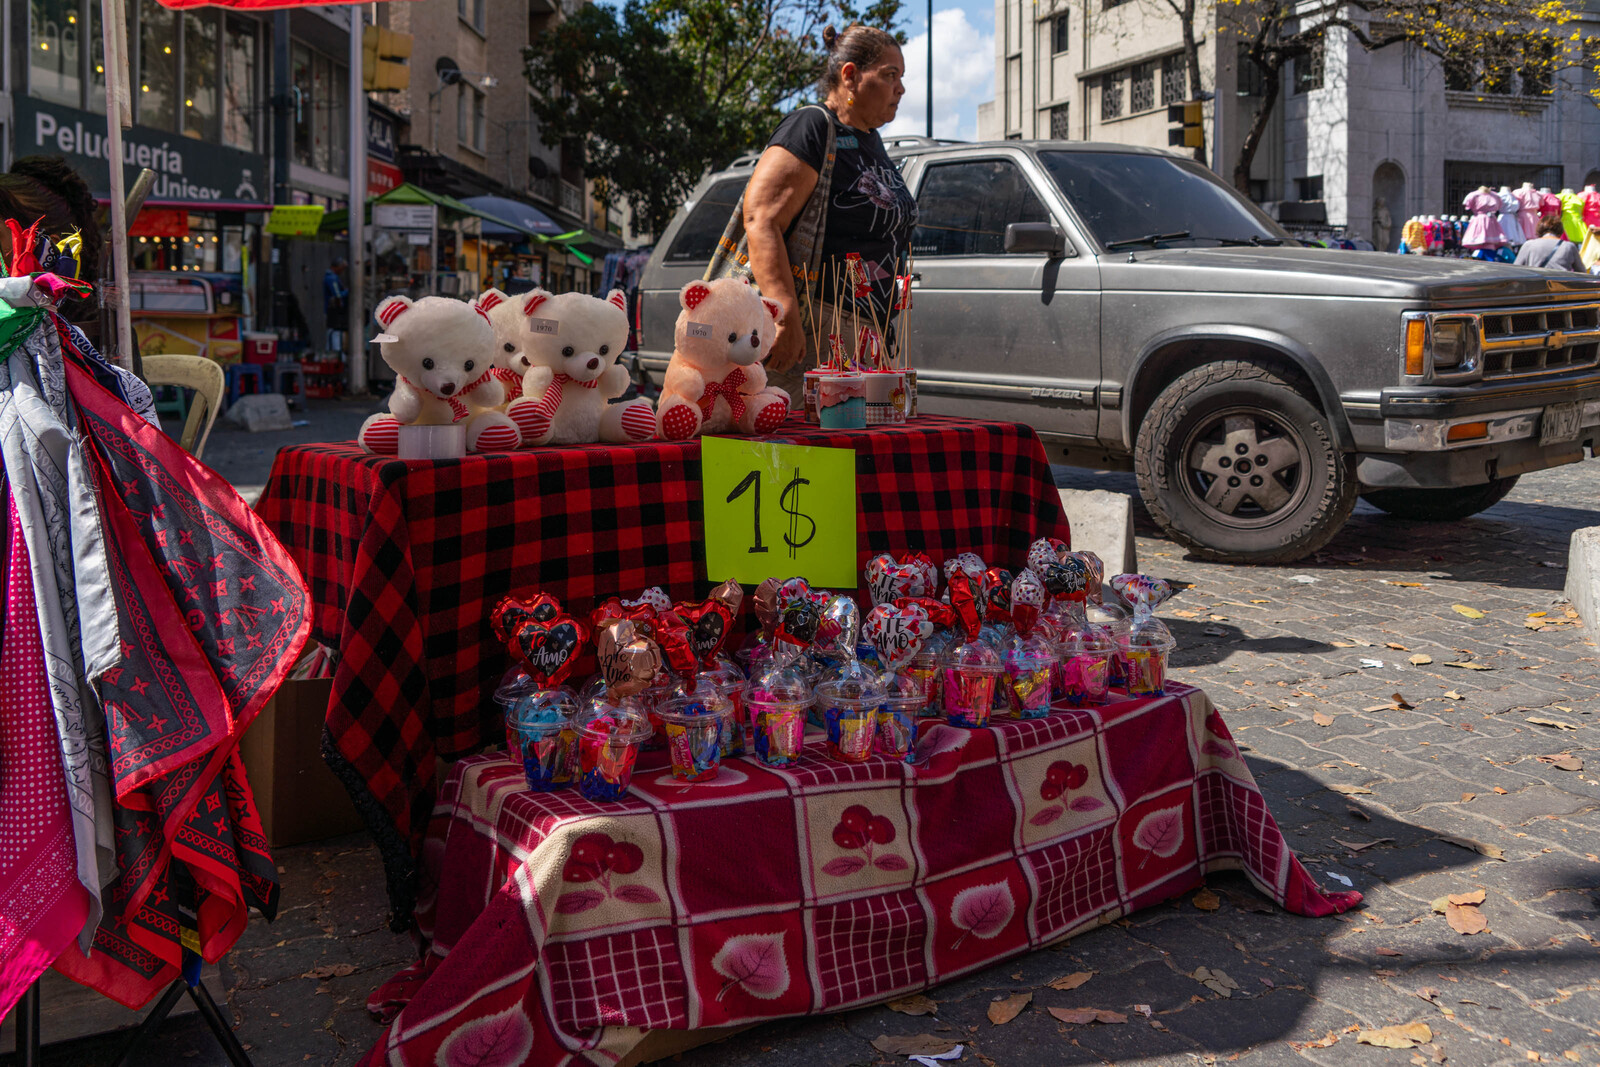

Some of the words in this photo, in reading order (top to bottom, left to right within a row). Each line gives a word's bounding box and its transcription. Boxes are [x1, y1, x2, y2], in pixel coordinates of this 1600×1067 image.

[536, 324, 553, 333] 1970
[692, 328, 708, 337] 1970
[1030, 386, 1083, 400] BLAZER
[881, 572, 901, 592] TE
[884, 617, 906, 633] TE
[530, 630, 547, 650] Te
[696, 637, 718, 651] mo
[876, 632, 909, 650] AMO
[532, 646, 568, 667] Amo
[677, 732, 690, 769] Trululu
